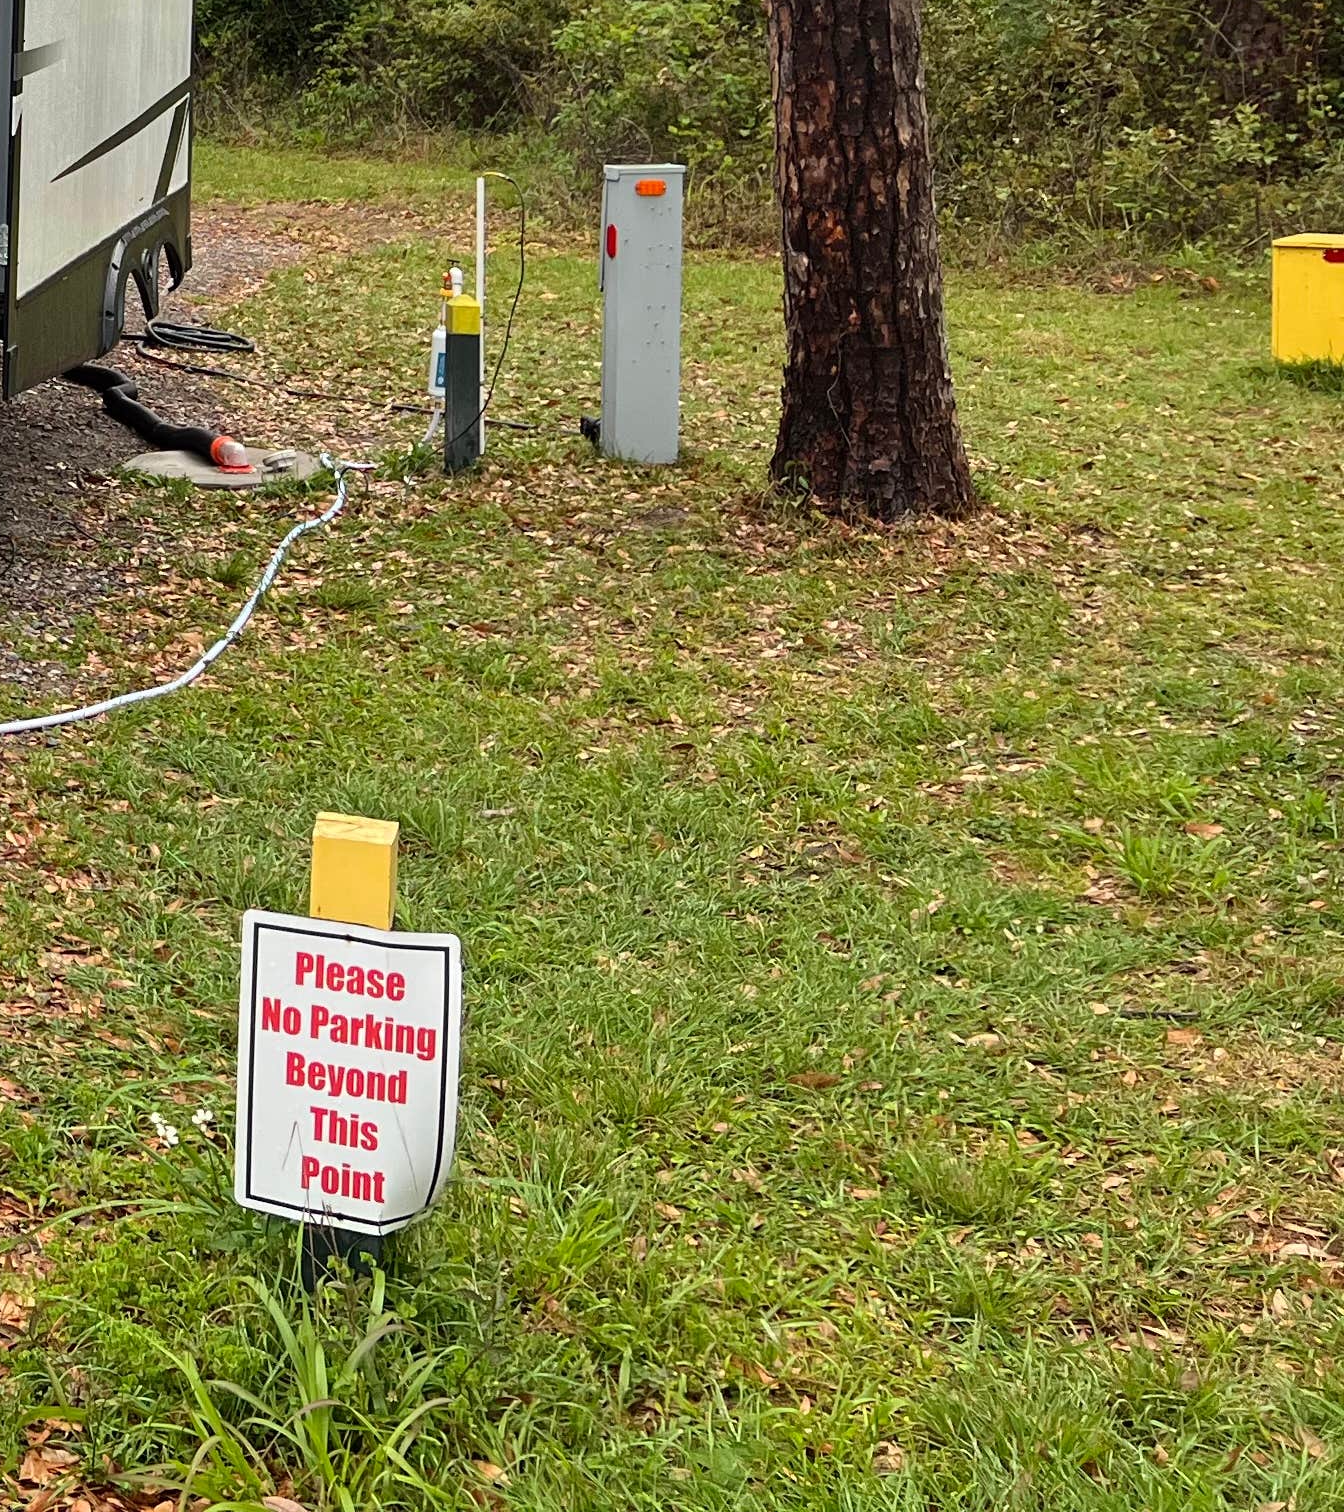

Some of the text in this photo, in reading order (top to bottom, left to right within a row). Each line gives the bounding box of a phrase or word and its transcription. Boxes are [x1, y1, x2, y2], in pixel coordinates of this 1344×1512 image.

[296, 952, 406, 1001] Please
[262, 997, 436, 1061] No Parking
[286, 1051, 408, 1104] Beyond
[310, 1106, 378, 1151] This
[301, 1155, 385, 1204] Point
